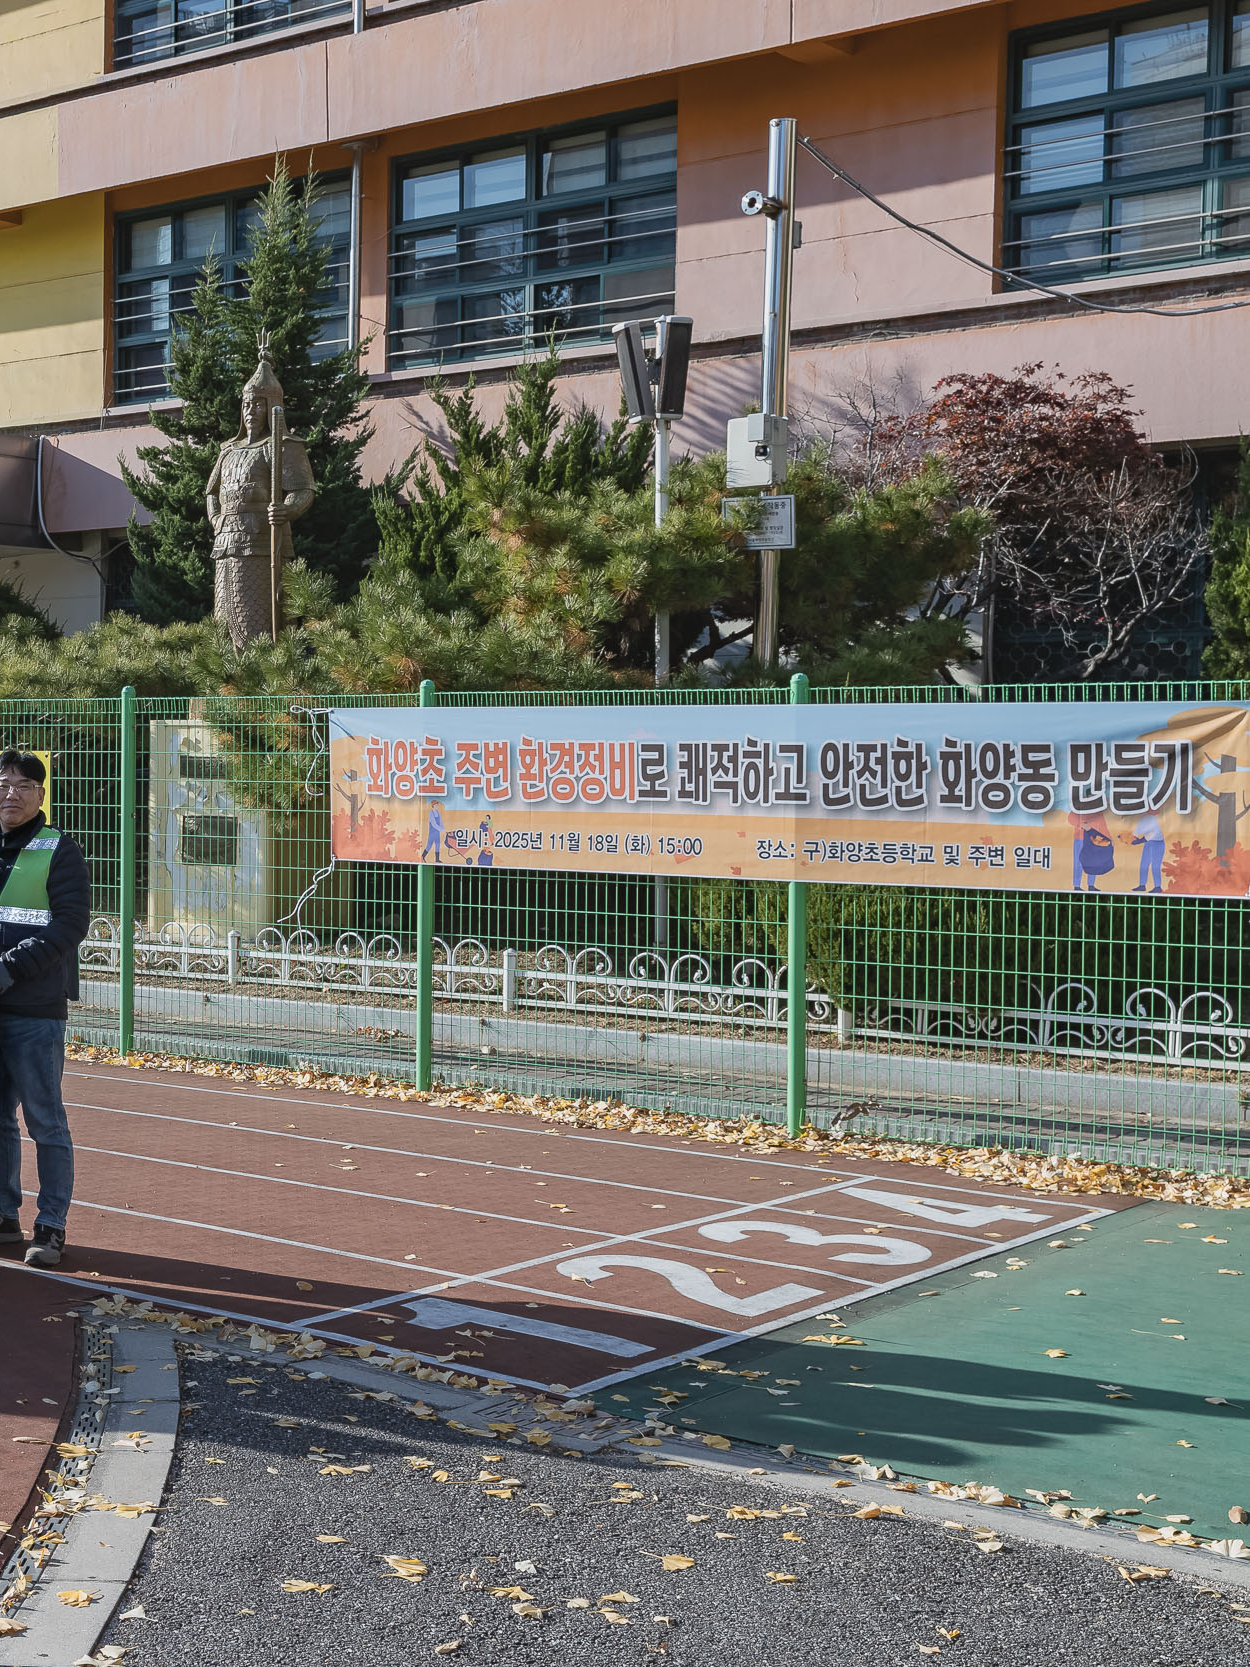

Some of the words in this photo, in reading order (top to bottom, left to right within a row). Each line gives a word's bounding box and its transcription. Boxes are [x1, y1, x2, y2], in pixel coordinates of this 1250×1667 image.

[365, 734, 447, 798] 화양초
[453, 739, 512, 801] 주변
[518, 733, 670, 803] 환경정비로
[676, 735, 810, 807] 쾌적하고
[819, 734, 930, 811] 안전한
[937, 734, 1058, 813] 화양동
[1067, 739, 1193, 815] 만들기
[454, 829, 490, 848] 일시:
[494, 831, 543, 850] 2025년
[549, 832, 581, 852] 11월
[587, 834, 619, 853] 18일
[624, 834, 651, 856] (화)
[658, 837, 703, 856] 15:00
[756, 839, 796, 859] 장소:
[803, 841, 936, 864] 구)화양초등학교
[942, 844, 961, 866] 및
[967, 845, 1005, 867] 주변
[1013, 846, 1051, 869] 일대
[839, 1187, 1053, 1228] 4
[697, 1220, 932, 1266] 3
[556, 1254, 826, 1317] 2
[402, 1297, 656, 1358] 1
